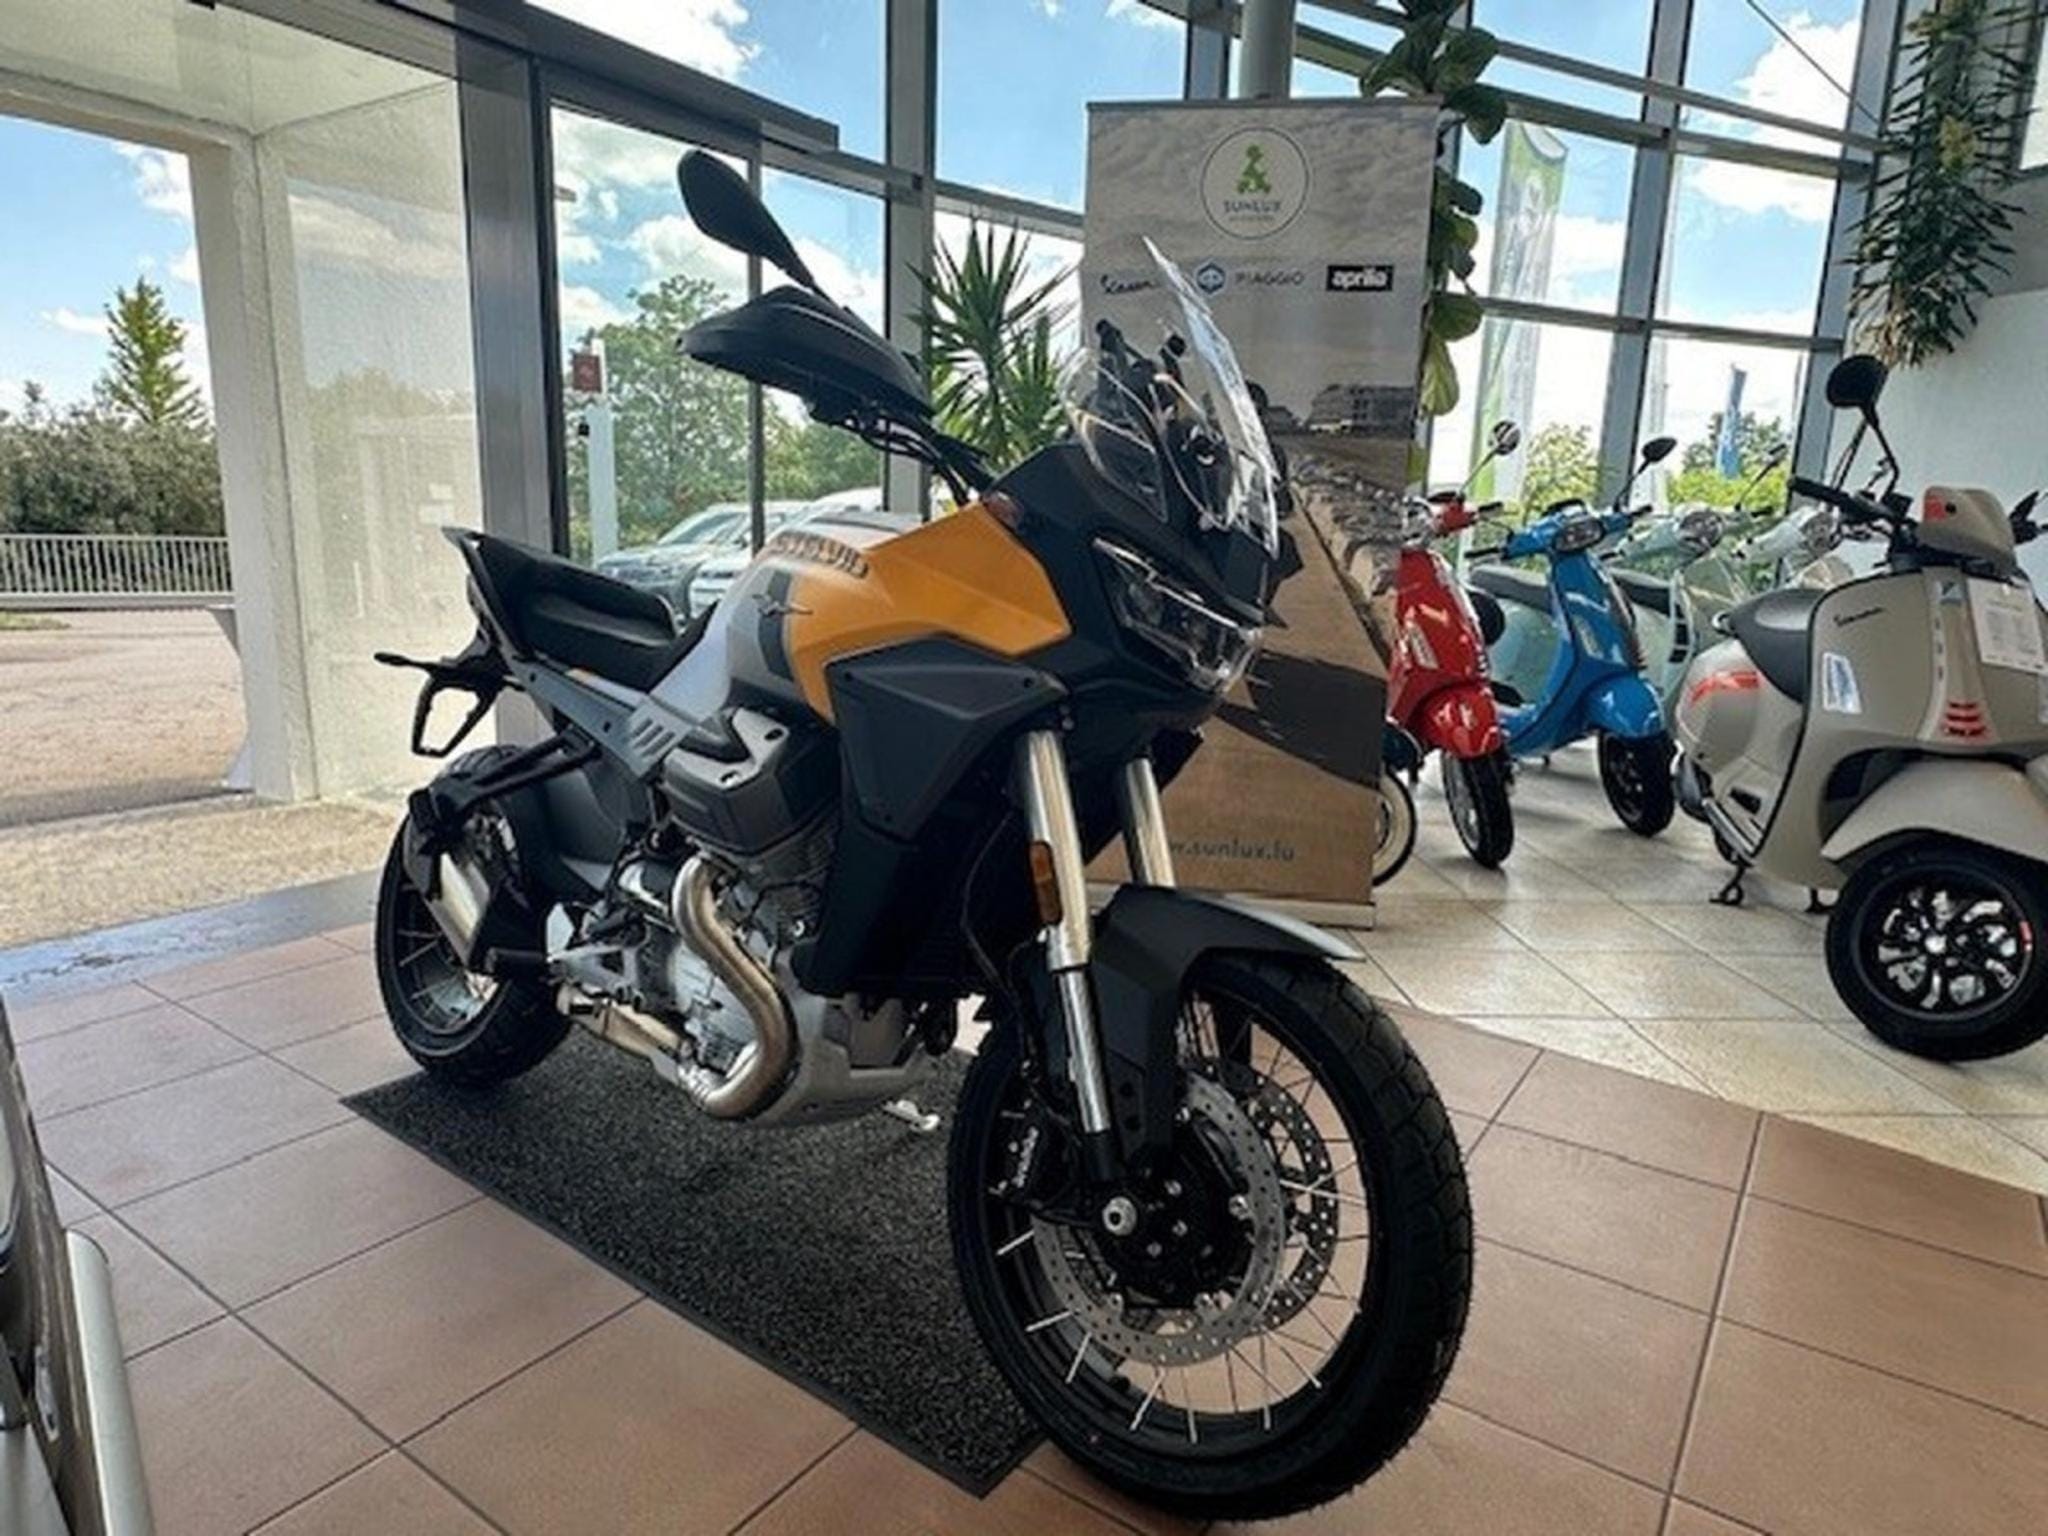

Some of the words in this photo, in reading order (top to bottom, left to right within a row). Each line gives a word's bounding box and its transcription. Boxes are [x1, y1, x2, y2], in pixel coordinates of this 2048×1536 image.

[1235, 269, 1305, 287] PIAGGIO
[1330, 266, 1389, 290] aprilia
[1168, 838, 1295, 861] w.sunlux.lu
